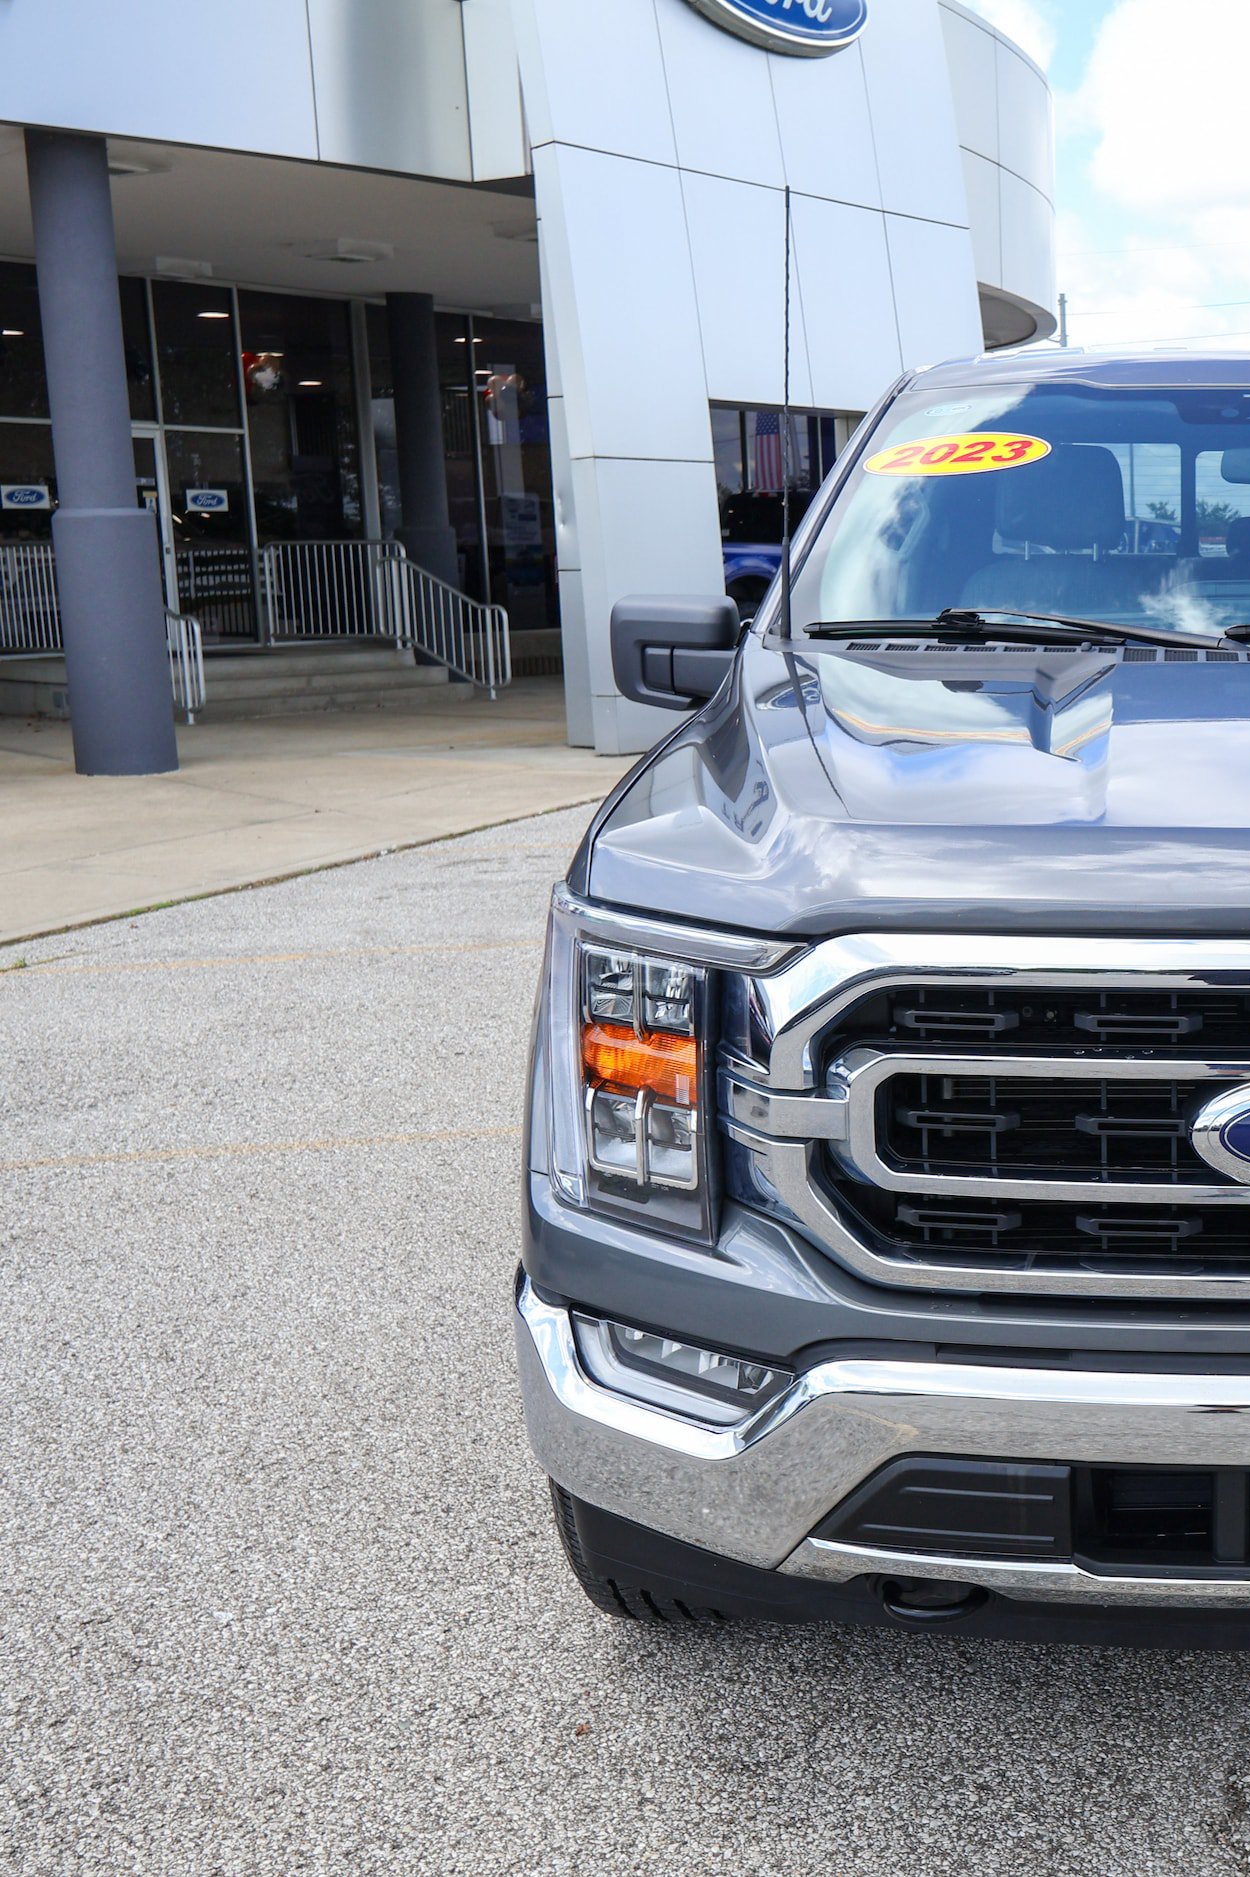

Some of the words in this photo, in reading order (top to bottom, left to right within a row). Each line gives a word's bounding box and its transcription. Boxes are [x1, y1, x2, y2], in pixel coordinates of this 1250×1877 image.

[880, 441, 1033, 470] 2023
[12, 490, 38, 502] Ford
[196, 494, 219, 506] Ford
